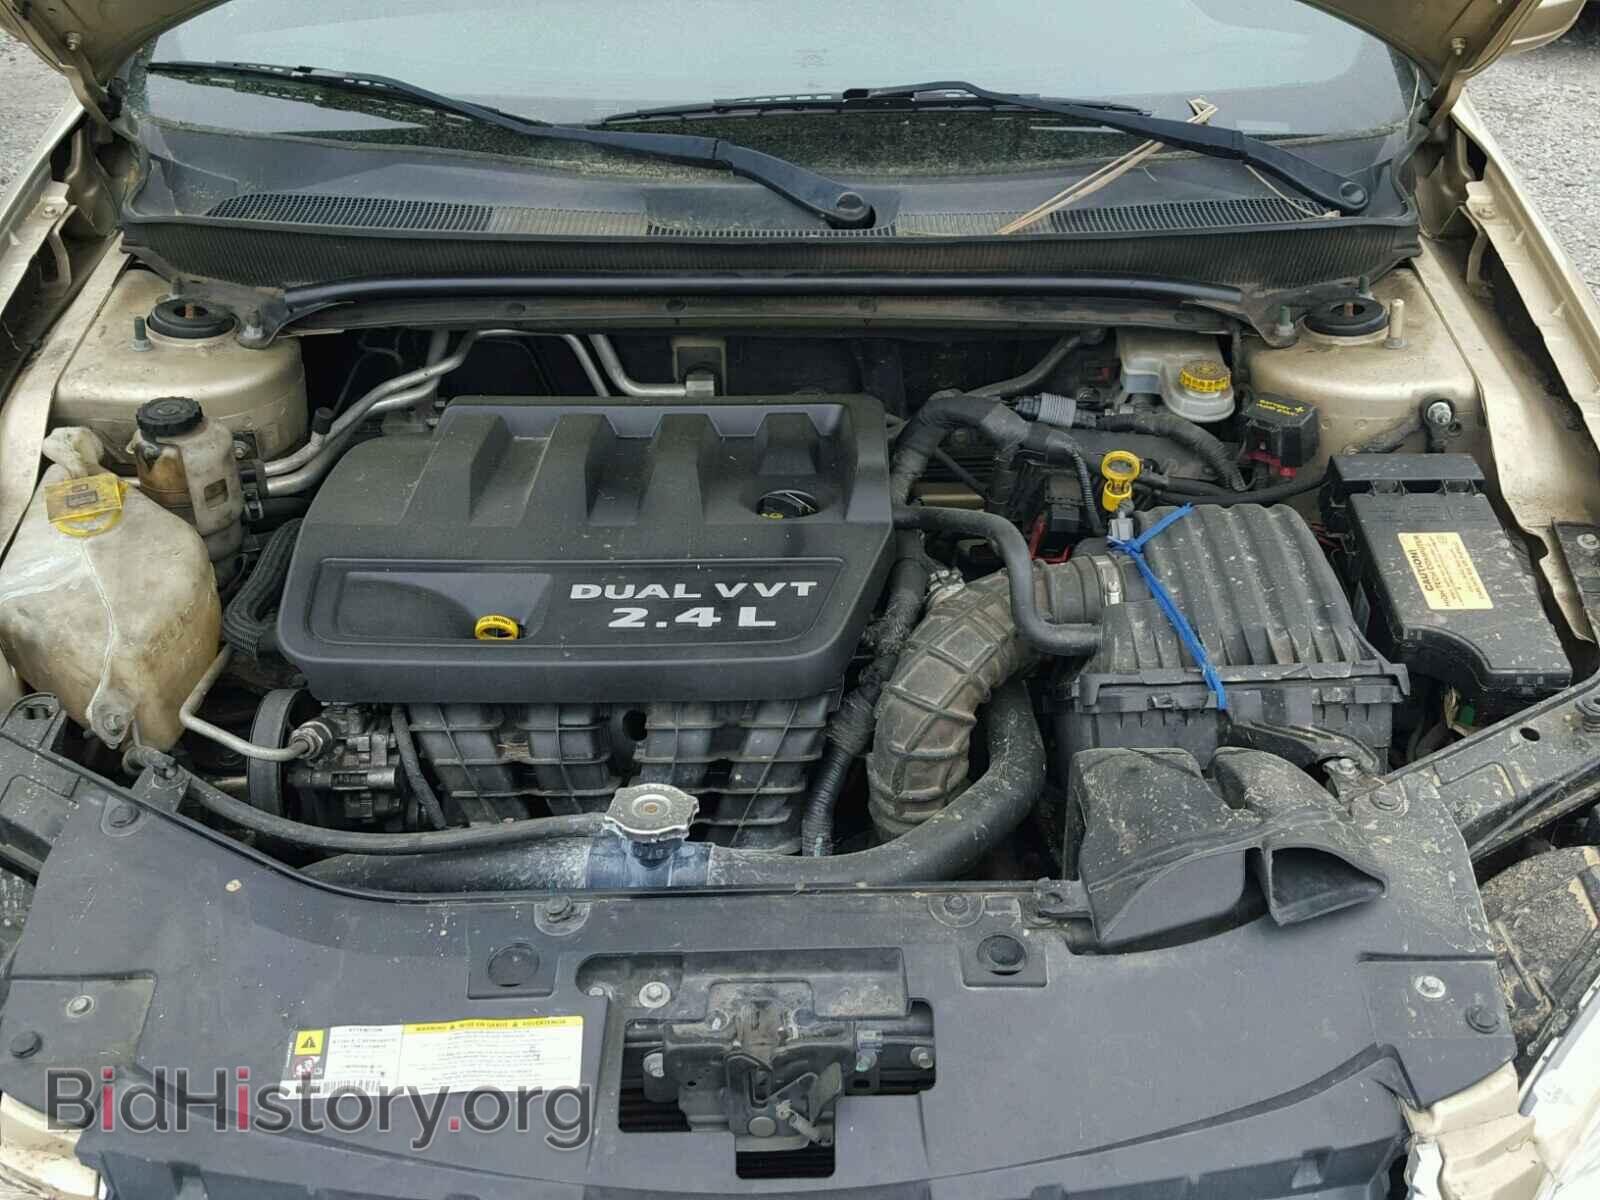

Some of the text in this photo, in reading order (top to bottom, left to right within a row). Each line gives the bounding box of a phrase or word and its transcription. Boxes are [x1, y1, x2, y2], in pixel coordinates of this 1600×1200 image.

[1408, 549, 1434, 591] CAUTION!
[569, 581, 818, 600] DUAL VVT
[608, 606, 776, 628] 2.4 L
